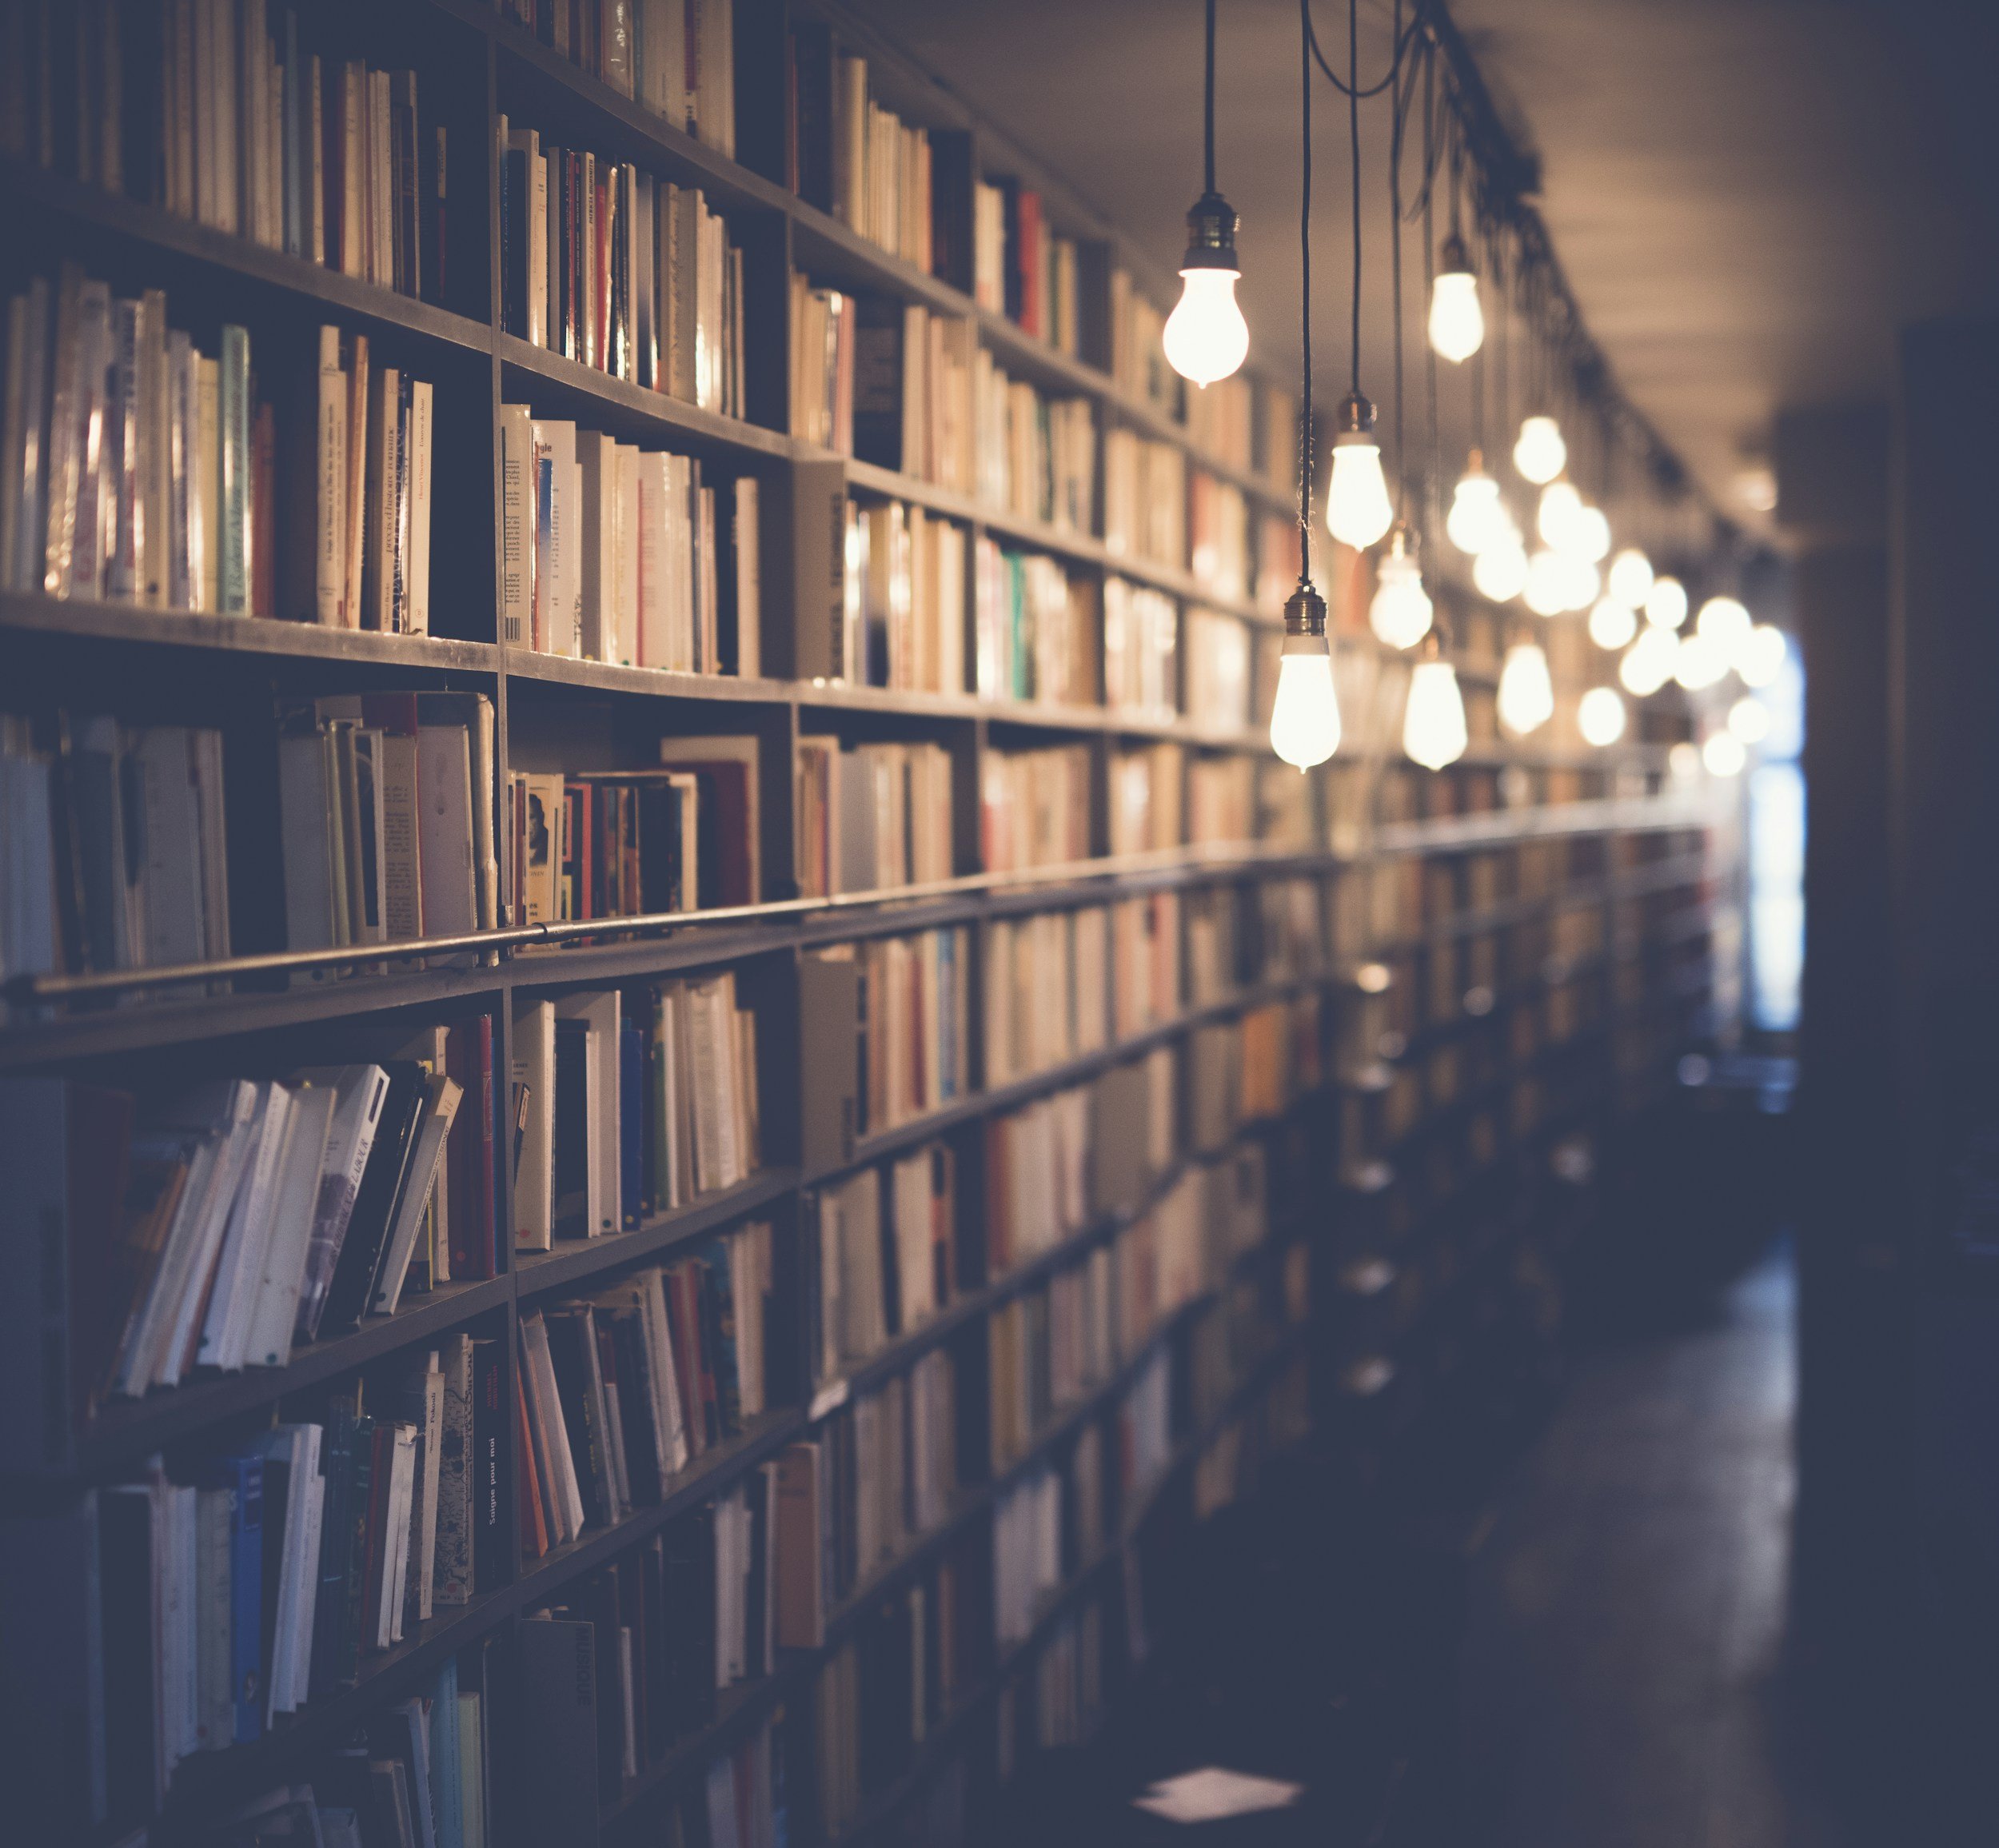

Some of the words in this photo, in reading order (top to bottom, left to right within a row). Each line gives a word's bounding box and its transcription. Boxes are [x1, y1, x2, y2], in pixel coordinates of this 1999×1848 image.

[538, 443, 552, 453] gle
[350, 1138, 369, 1183] LABOUR
[575, 1626, 592, 1706] MUSIQUE
